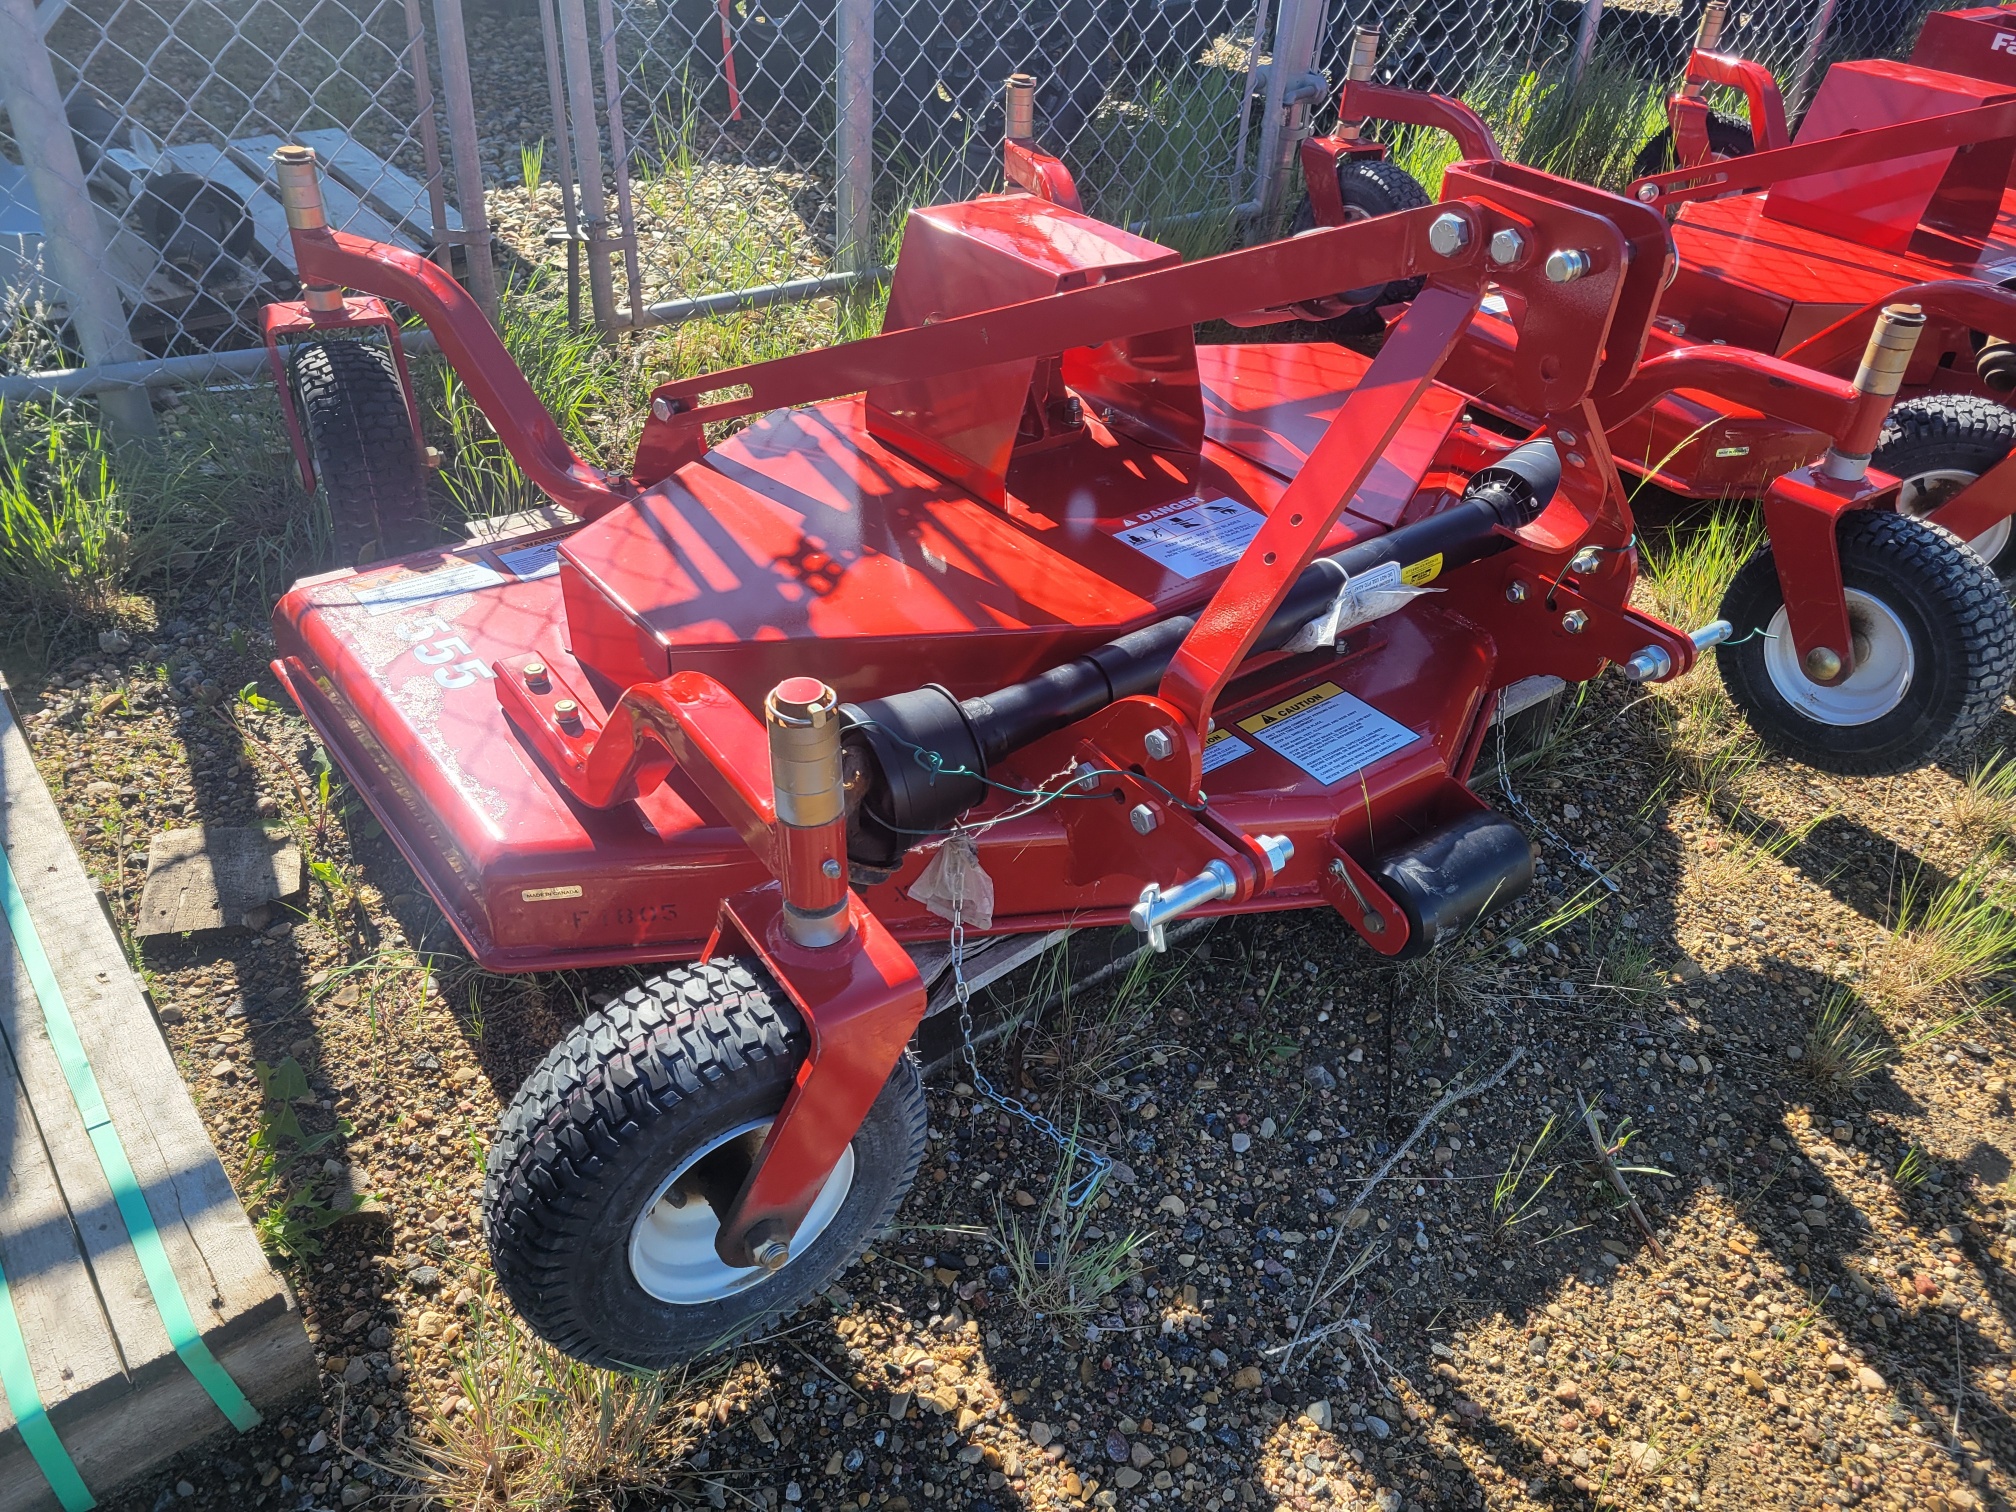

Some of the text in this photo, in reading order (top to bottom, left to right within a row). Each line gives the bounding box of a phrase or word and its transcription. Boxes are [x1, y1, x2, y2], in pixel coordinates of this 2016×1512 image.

[1136, 496, 1205, 521] DANGER
[394, 614, 498, 689] 555
[1278, 694, 1323, 717] CAUTION
